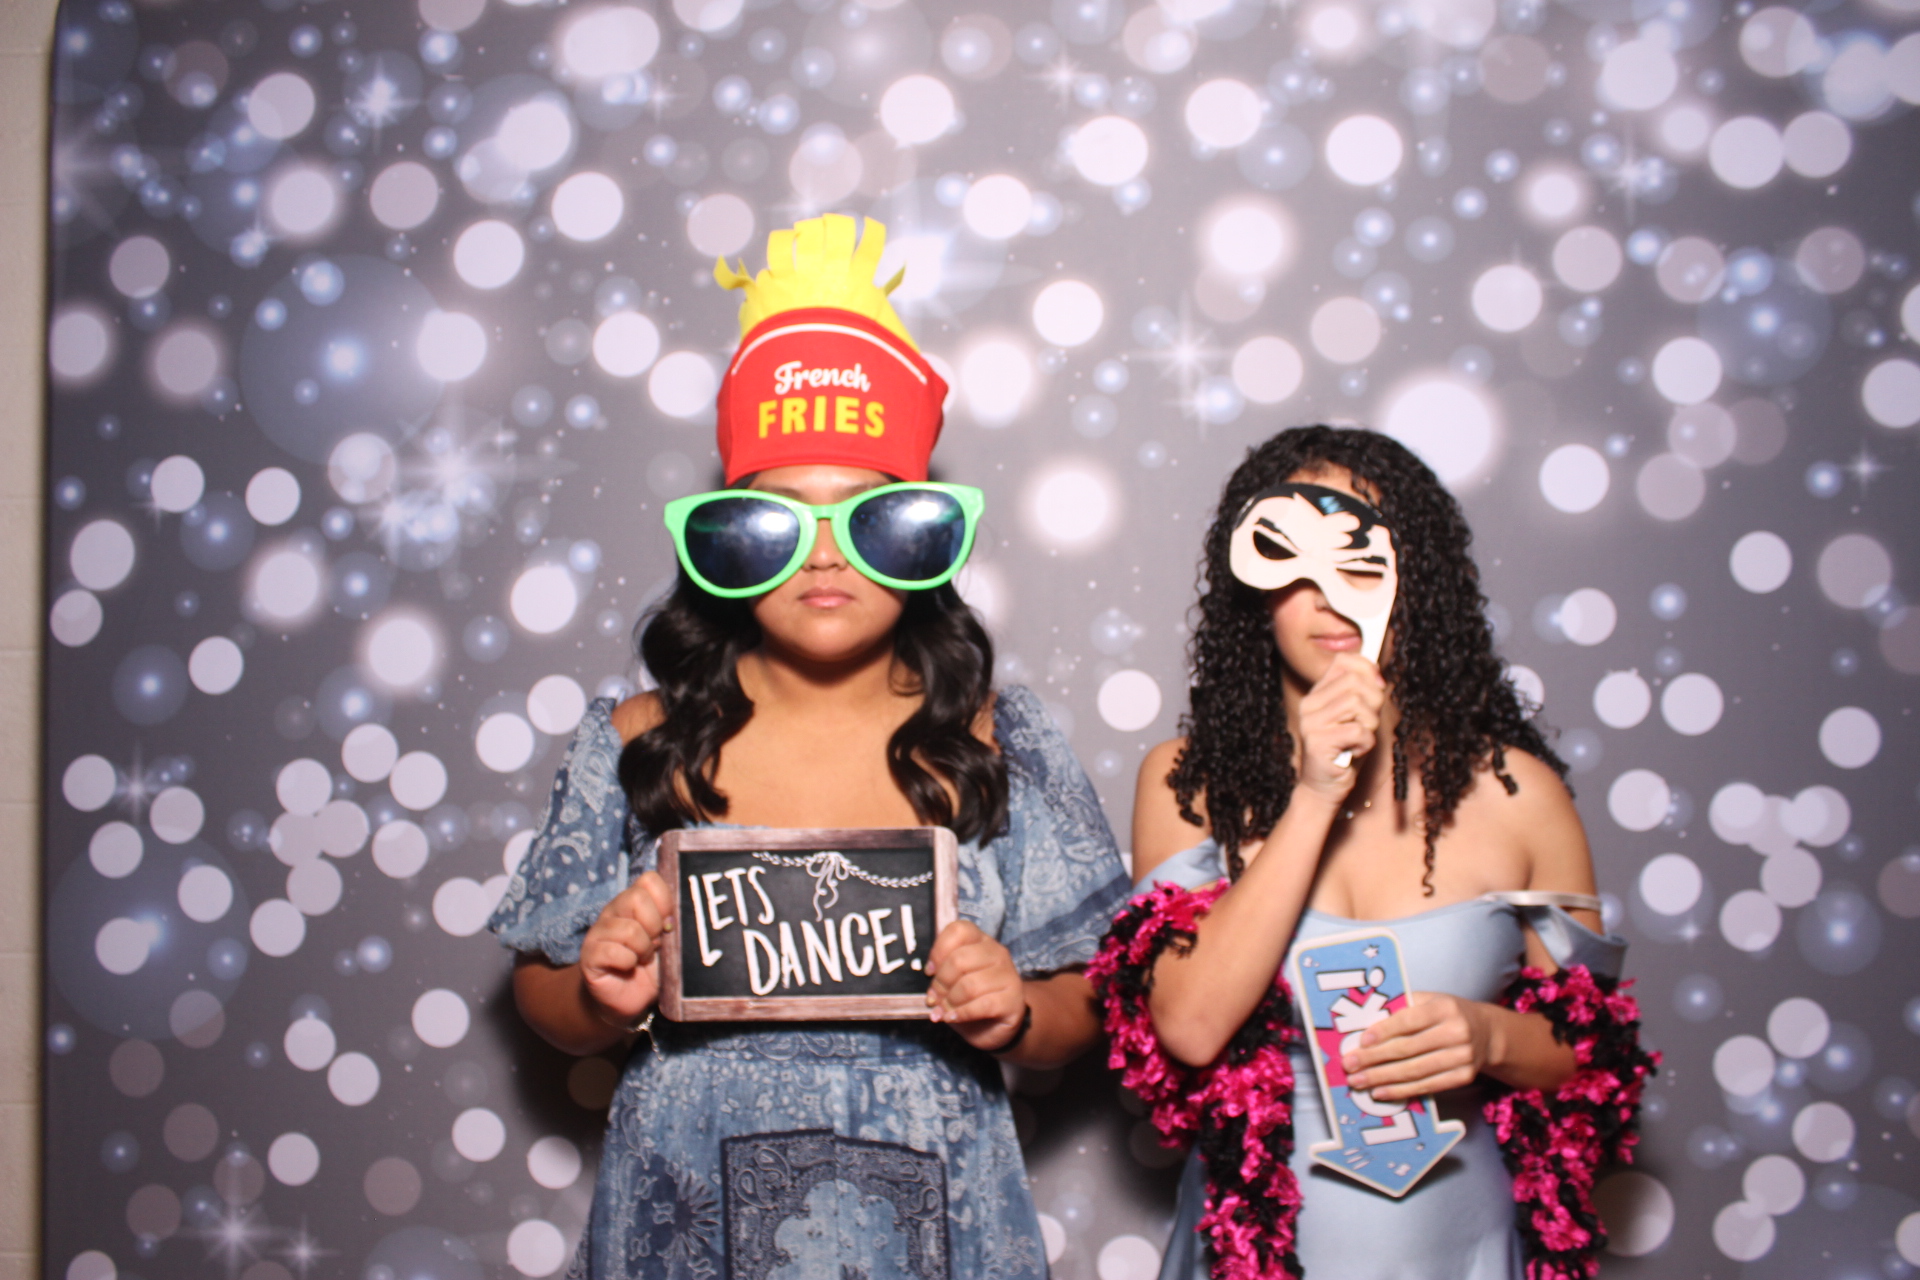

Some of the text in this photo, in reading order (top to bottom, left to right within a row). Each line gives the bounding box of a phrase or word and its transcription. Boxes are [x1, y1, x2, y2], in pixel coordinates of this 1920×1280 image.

[774, 360, 871, 395] French
[758, 395, 885, 439] FRIES
[688, 865, 775, 967] LETS
[743, 904, 922, 996] DANCE!
